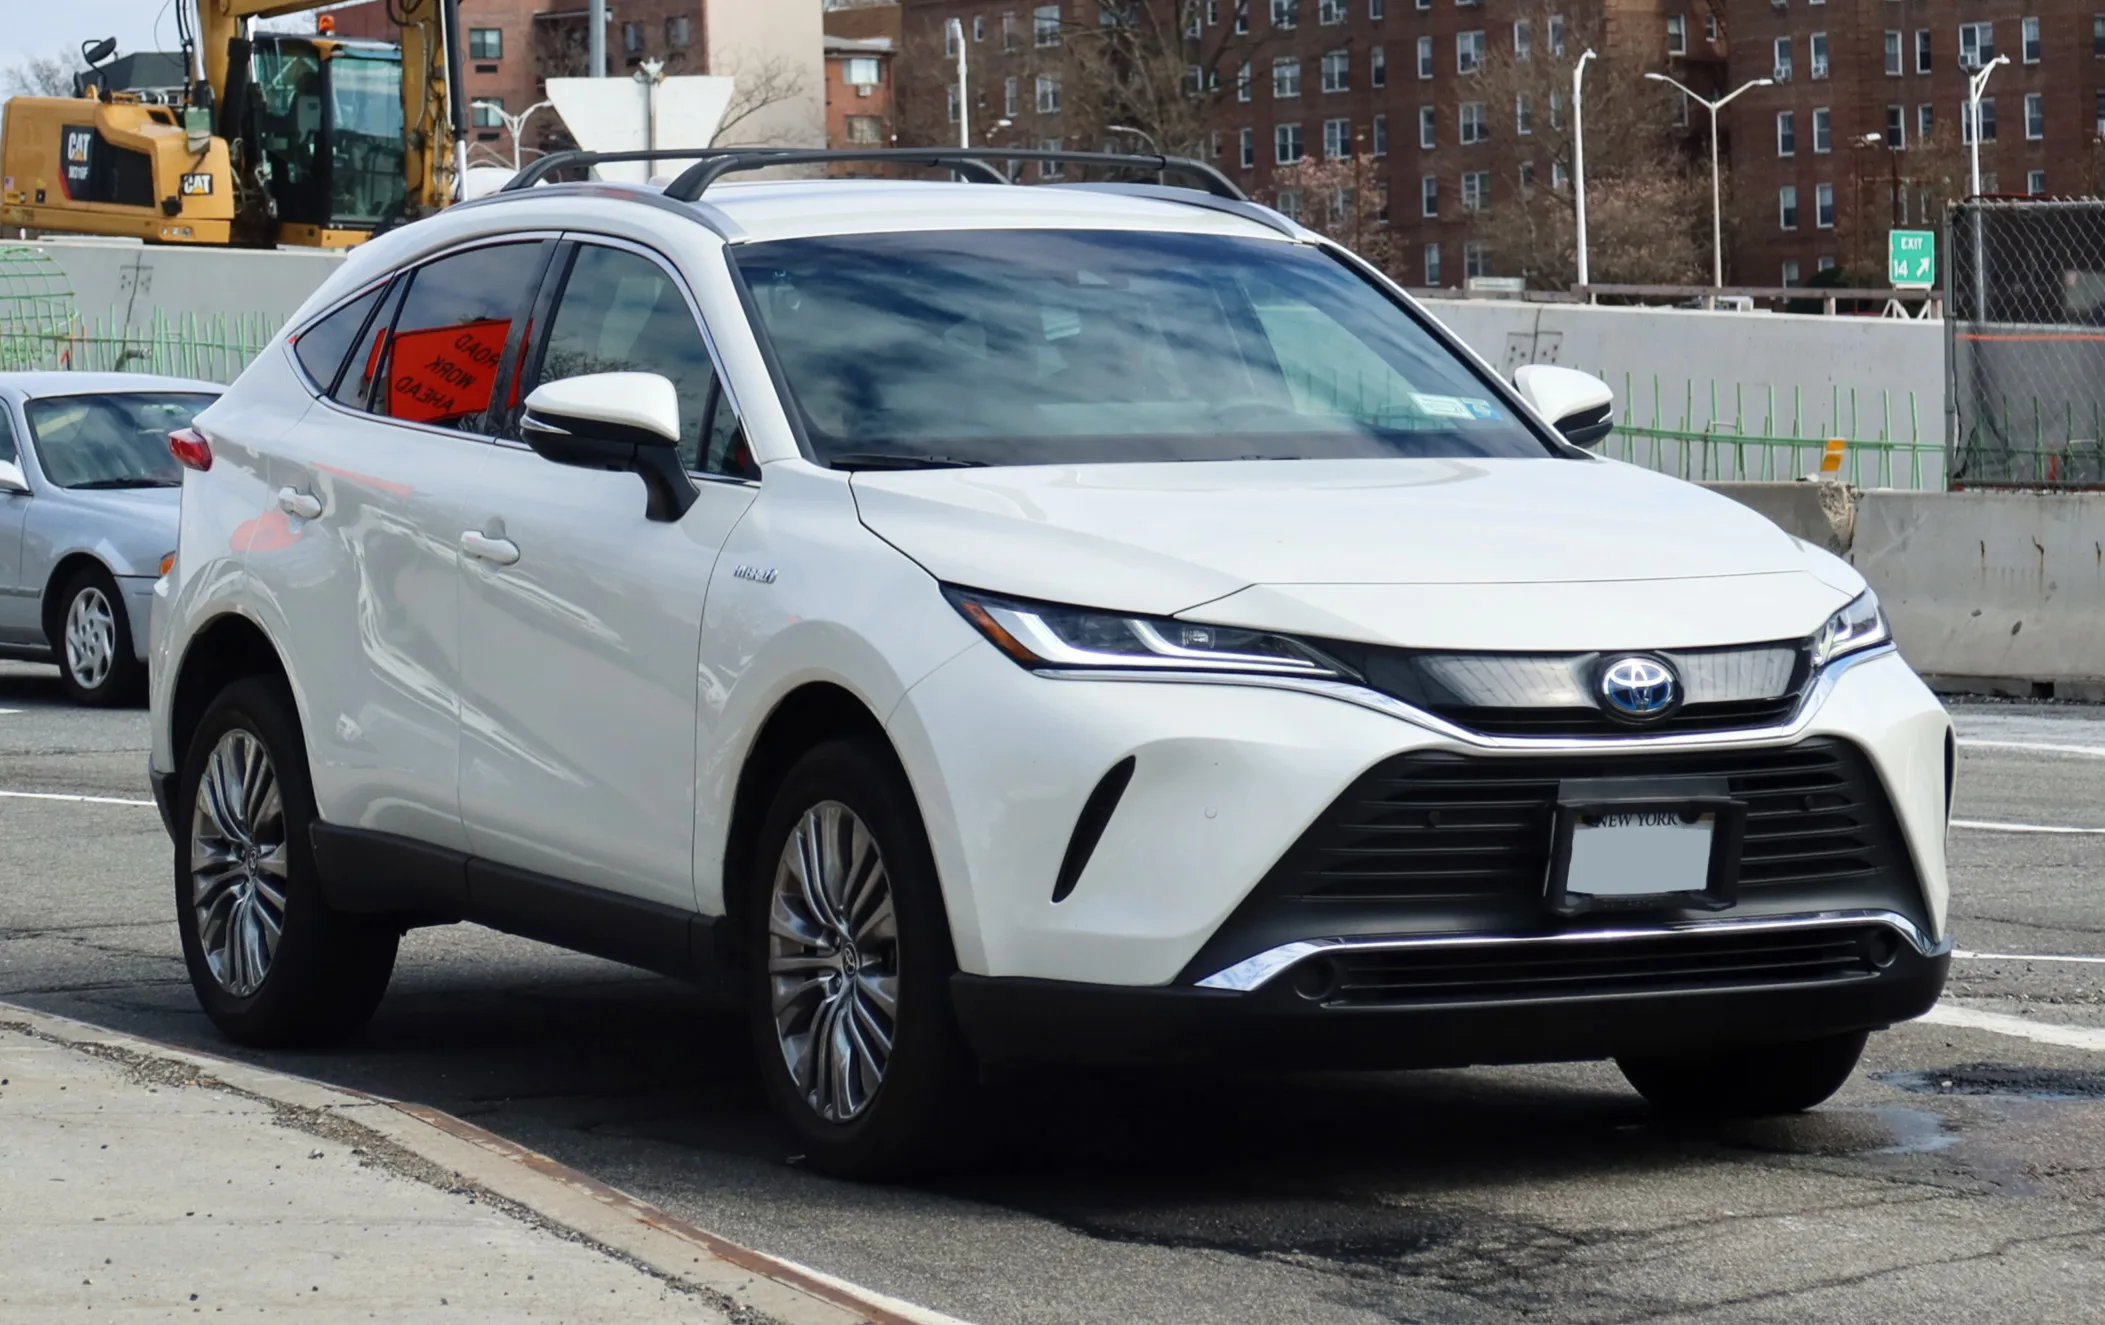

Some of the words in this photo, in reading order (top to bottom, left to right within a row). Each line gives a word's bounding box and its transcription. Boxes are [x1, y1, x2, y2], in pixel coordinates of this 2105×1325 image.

[68, 131, 91, 162] CAT
[183, 174, 211, 194] CAT
[1901, 236, 1923, 250] EXIT
[1893, 259, 1908, 278] 14
[1593, 813, 1632, 828] NEW
[1638, 812, 1679, 827] YORK
